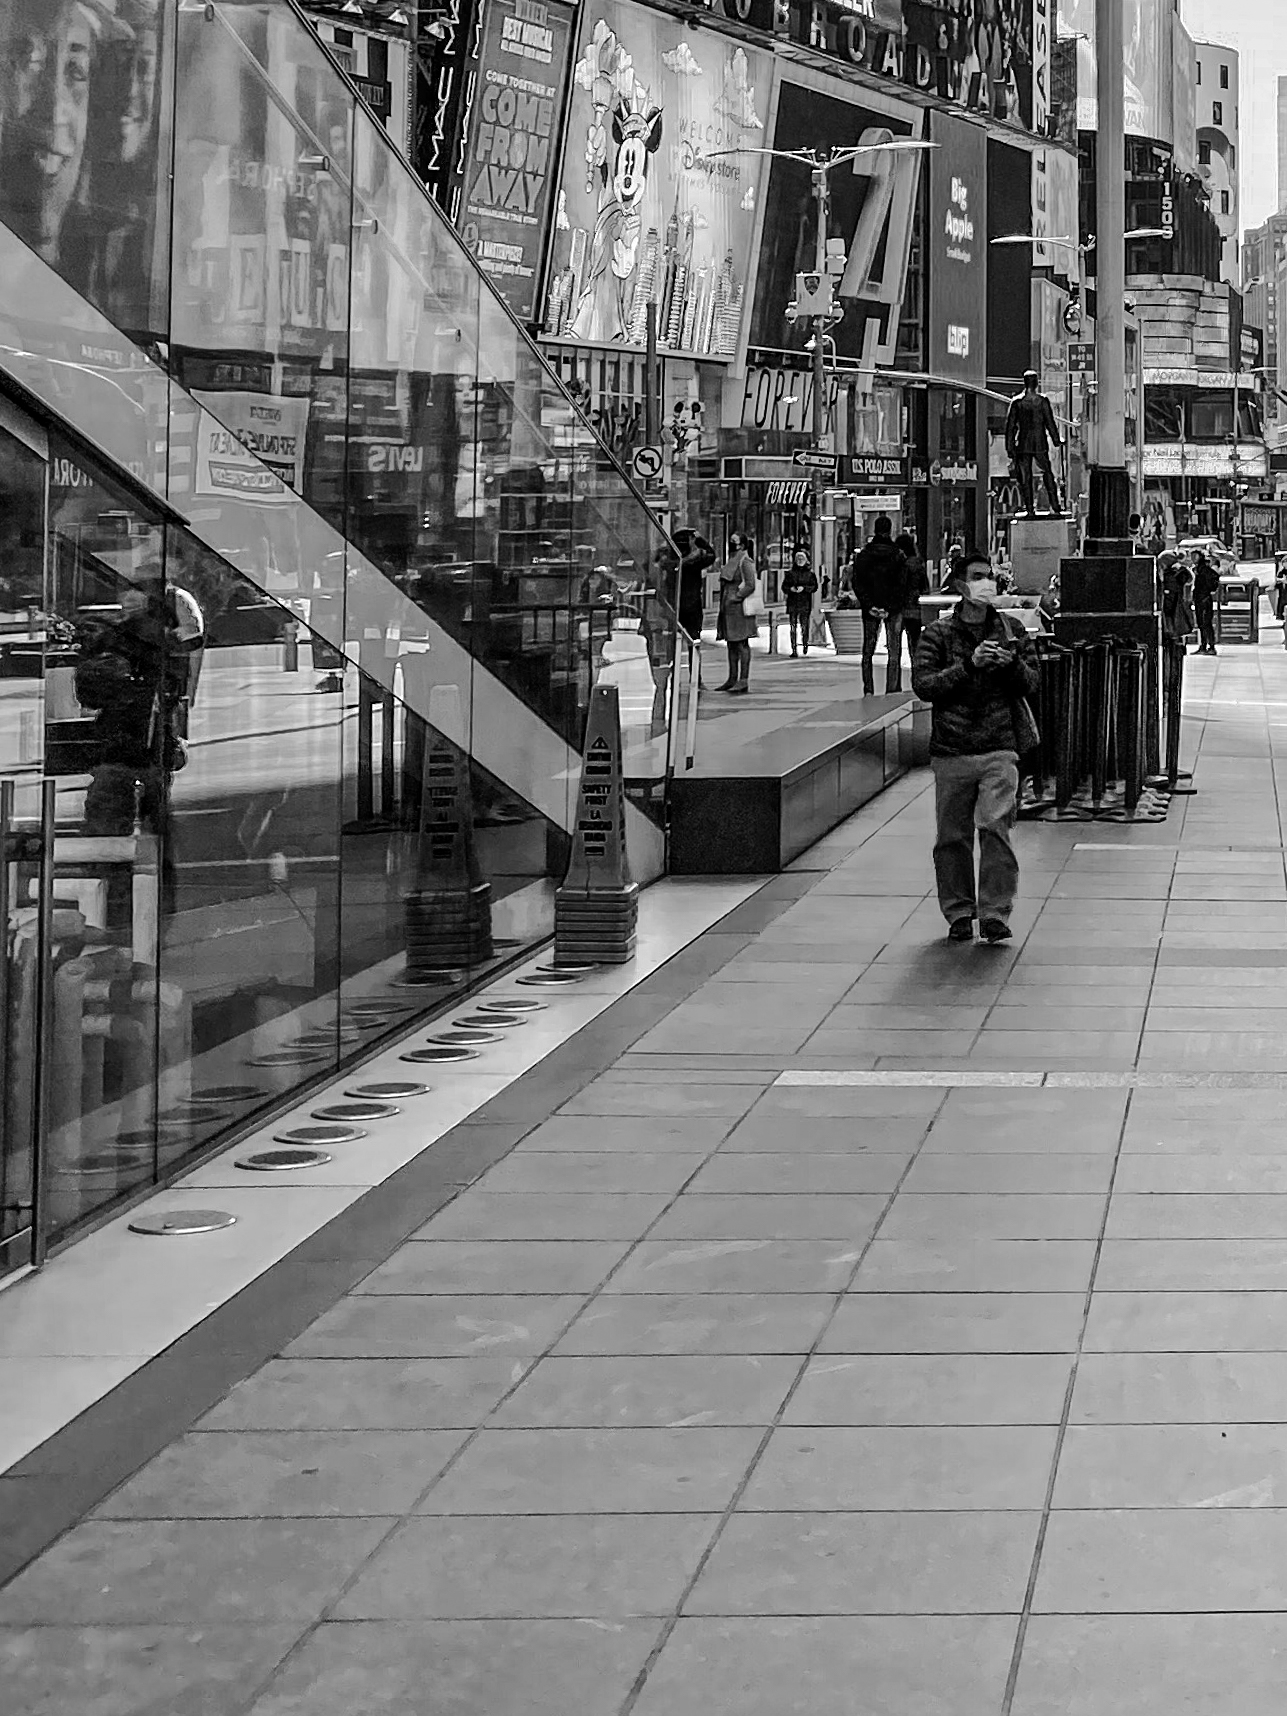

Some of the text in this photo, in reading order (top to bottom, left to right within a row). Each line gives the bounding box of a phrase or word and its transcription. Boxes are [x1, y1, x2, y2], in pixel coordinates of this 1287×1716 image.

[482, 84, 553, 138] COME
[476, 122, 549, 177] FROM
[470, 163, 545, 214] AWAY
[945, 208, 973, 243] Apple
[740, 366, 839, 434] FOREVR
